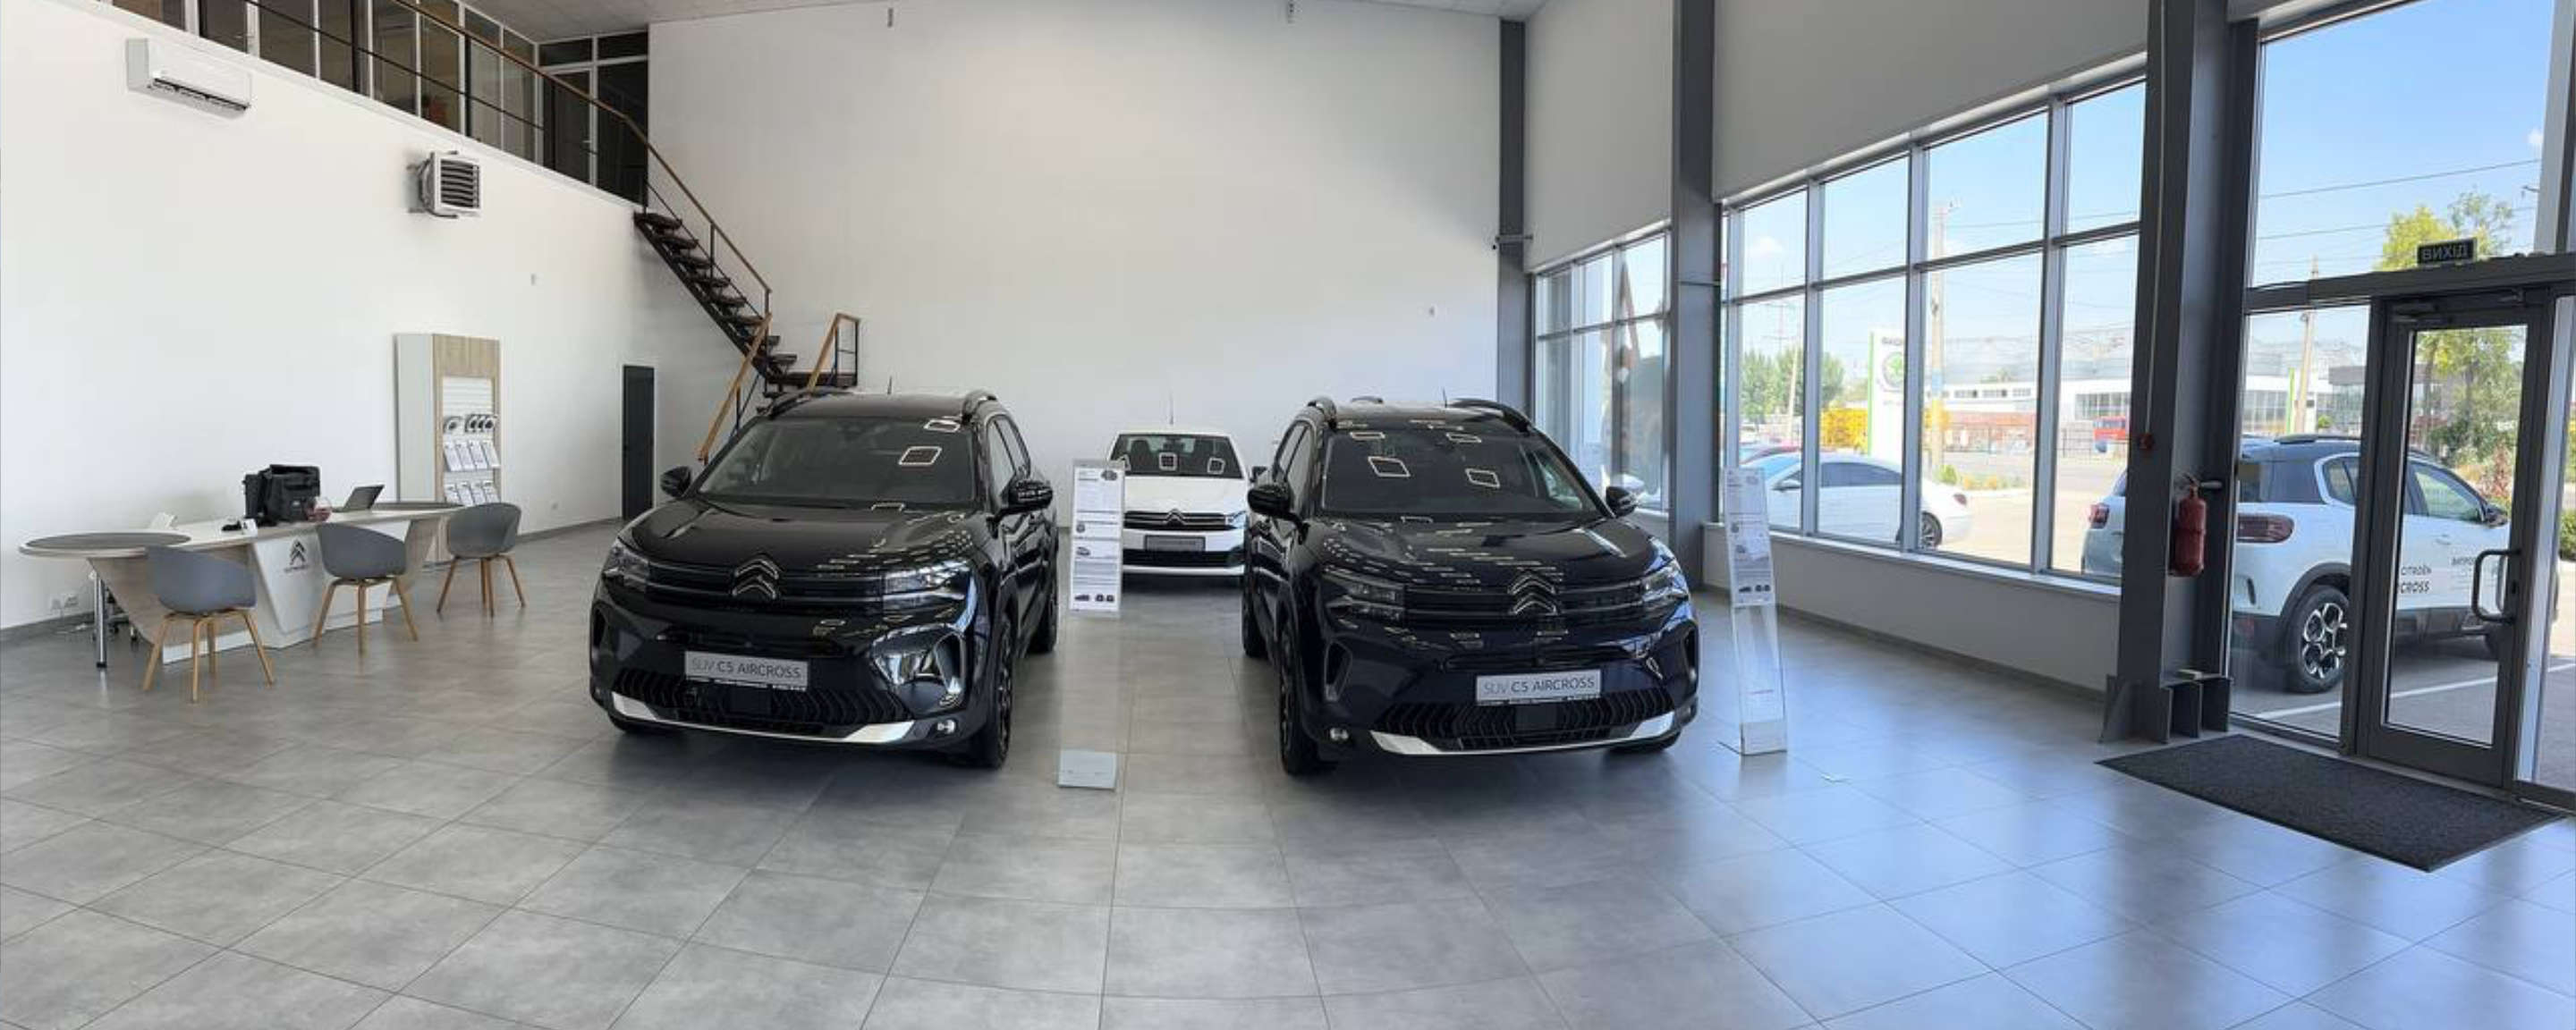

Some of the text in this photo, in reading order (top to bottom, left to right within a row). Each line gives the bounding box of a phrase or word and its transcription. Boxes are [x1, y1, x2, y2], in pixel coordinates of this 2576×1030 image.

[717, 661, 733, 673] C5
[737, 663, 801, 679] AIRCROSS
[1511, 681, 1529, 693] C5
[1531, 677, 1595, 691] AIRCROSS
